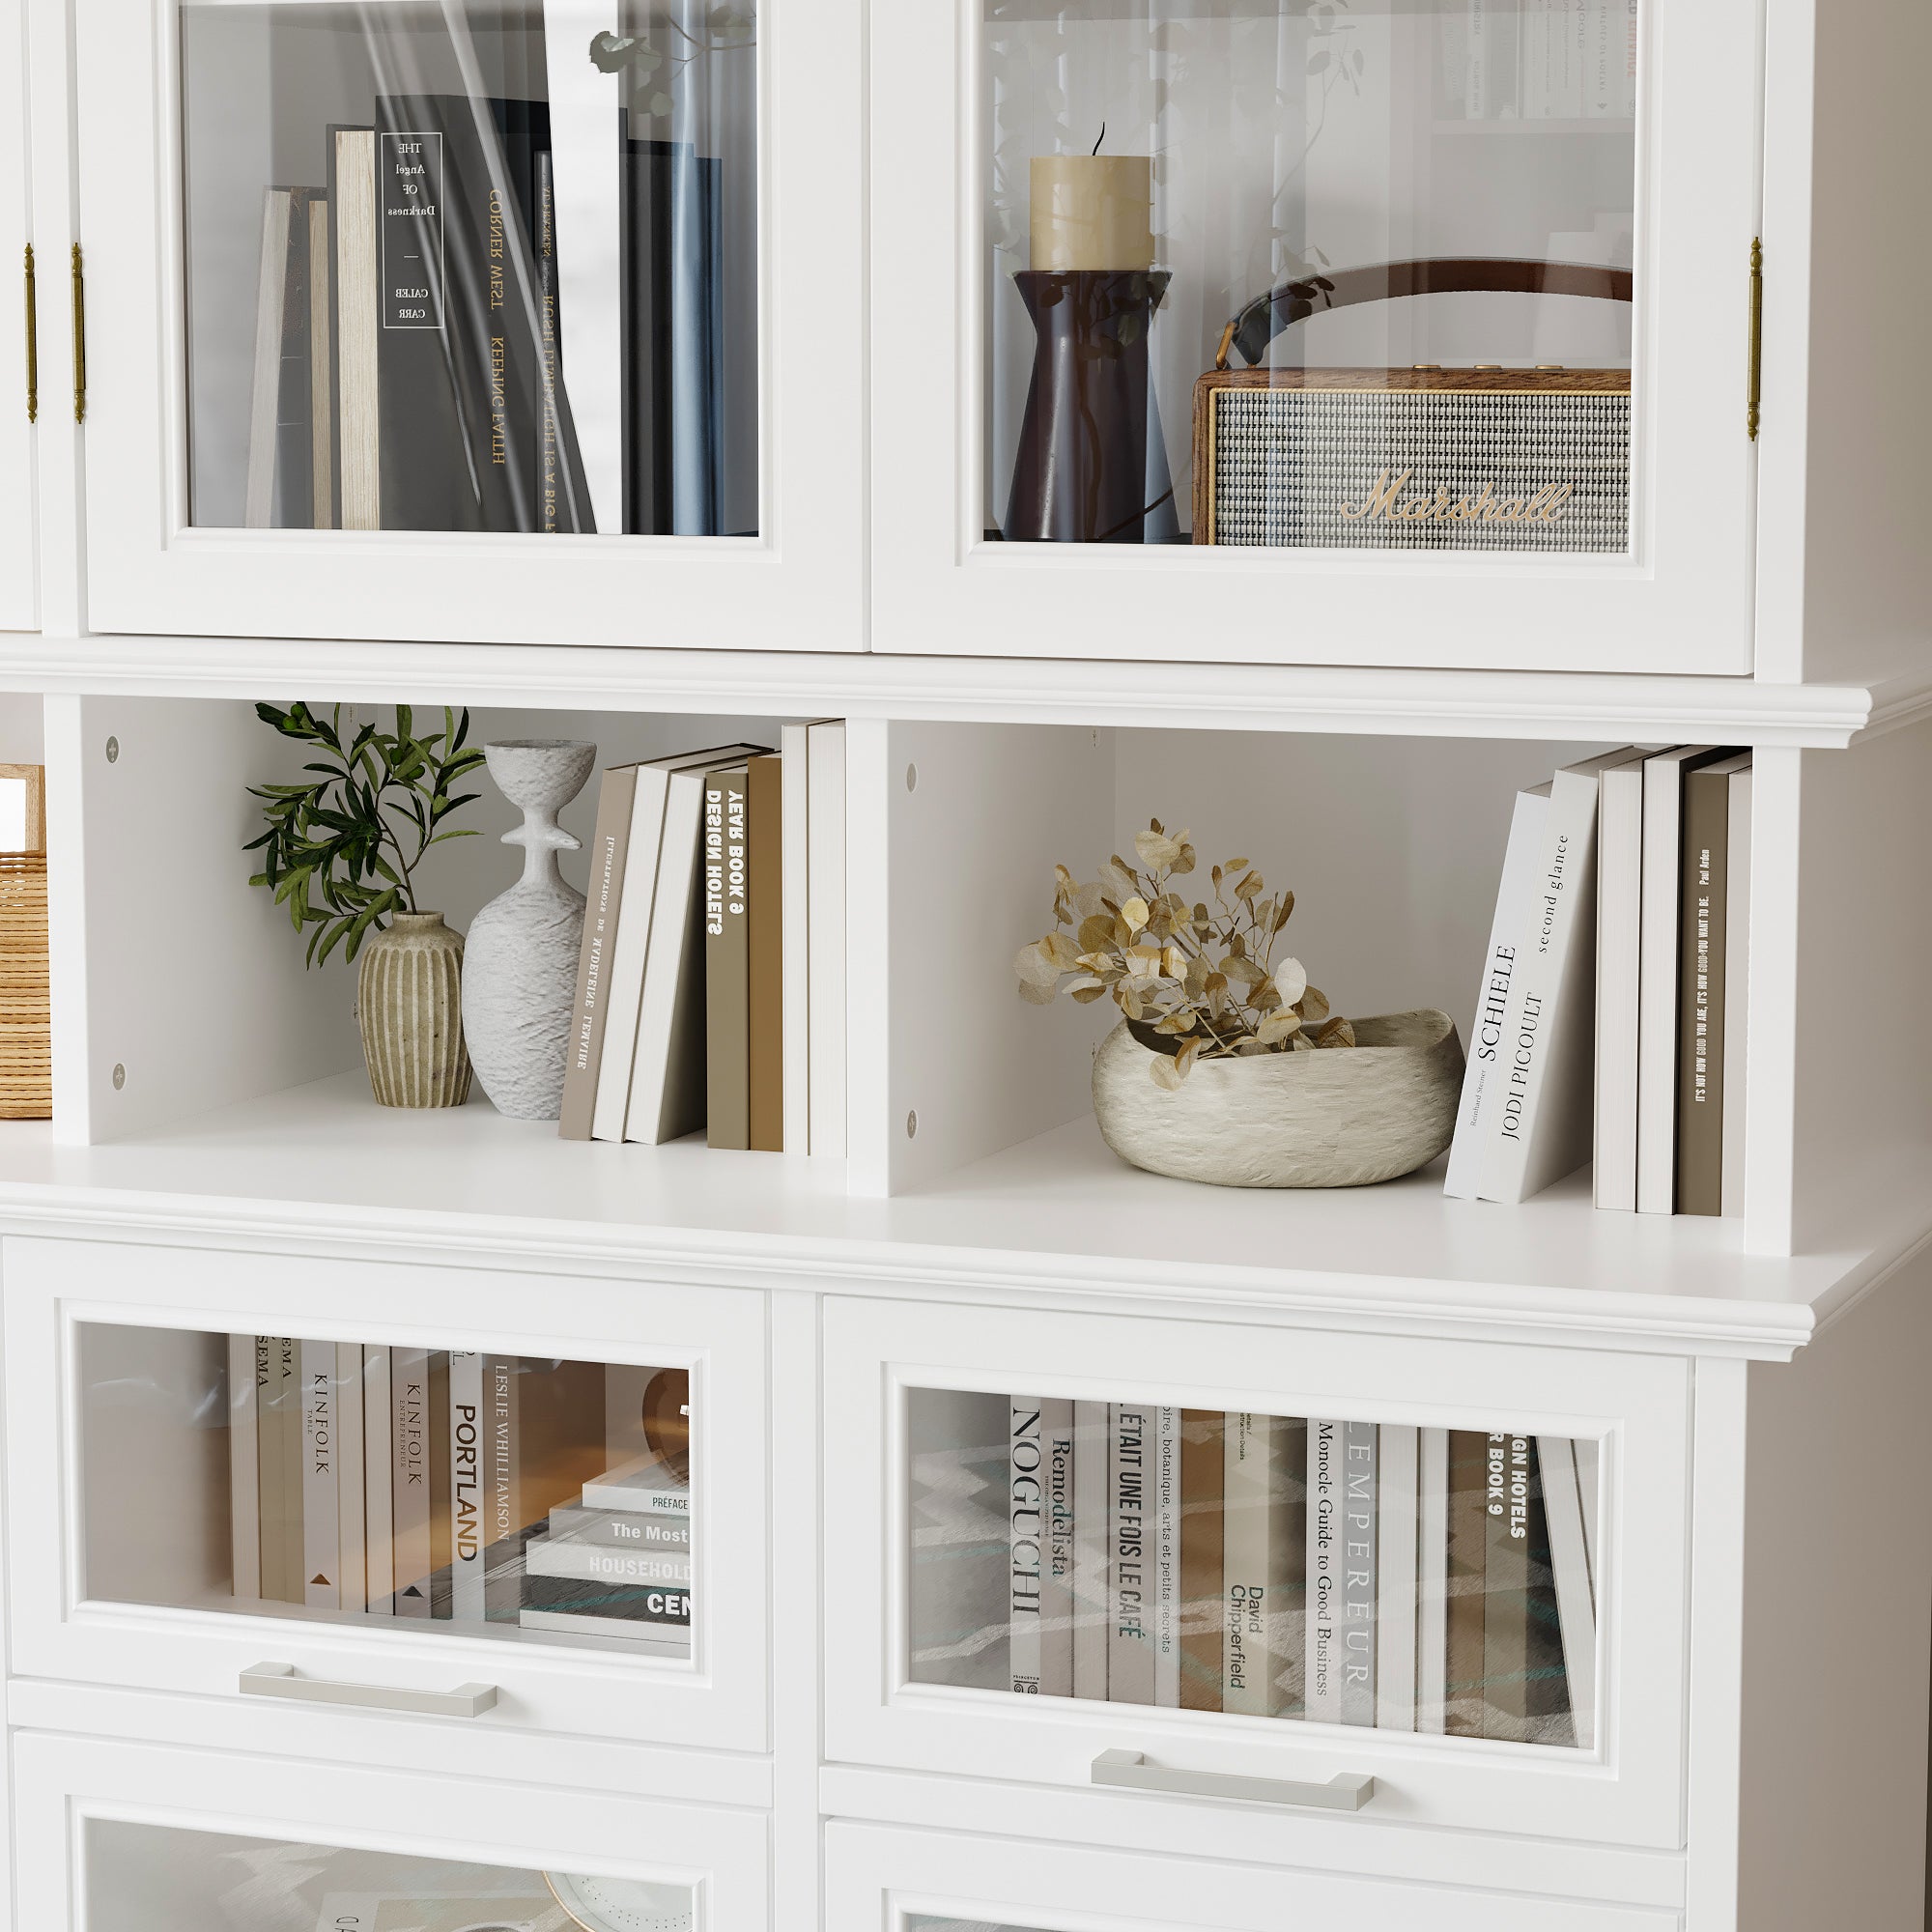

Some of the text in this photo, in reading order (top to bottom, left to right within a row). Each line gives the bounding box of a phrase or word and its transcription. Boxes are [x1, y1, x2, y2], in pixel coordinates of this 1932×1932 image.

[1340, 468, 1575, 523] Marshall
[1699, 849, 1710, 868] Arden
[1699, 869, 1710, 886] Paul
[1538, 835, 1570, 953] second glance
[1698, 895, 1710, 907] BE.
[1698, 908, 1710, 918] TO
[1698, 919, 1709, 938] WANT
[1477, 944, 1516, 1062] SCHIELE
[1696, 991, 1708, 1005] IT'S
[1697, 974, 1708, 990] HOW
[1696, 1006, 1708, 1022] ARE,
[1696, 1023, 1707, 1037] YOU
[1501, 990, 1543, 1142] JODI PICOULT
[1695, 1057, 1707, 1072] HOW
[1696, 1037, 1707, 1056] GOOD
[1468, 1068, 1487, 1127] Reinhard Steiner
[1695, 1073, 1706, 1088] NOT
[1695, 1089, 1706, 1102] IT'S
[314, 1374, 329, 1474] KINFOLK
[407, 1383, 422, 1485] KINFOLK
[495, 1364, 510, 1541] LESLIE WHILLIAMSON
[1160, 1439, 1173, 1508] botanique,
[1489, 1448, 1505, 1499] BOOK
[455, 1405, 478, 1562] PORTLAND
[652, 1496, 688, 1510] PRÉFACE
[1510, 1470, 1527, 1539] HOTELS
[1012, 1406, 1041, 1616] NOGUCHI
[1052, 1438, 1072, 1577] Remodelista
[1119, 1413, 1147, 1639] ÉTAIT UNE FOIS LE CAFÉ
[1162, 1512, 1172, 1541] arts
[1488, 1504, 1504, 1516] 9
[611, 1522, 689, 1543] The Most
[1162, 1545, 1172, 1558] et
[1317, 1421, 1333, 1696] Monocle Guide to Good Business
[1160, 1561, 1173, 1600] petits
[1162, 1605, 1172, 1653] secrets
[1248, 1586, 1264, 1634] David
[1228, 1584, 1246, 1690] Chipperfield
